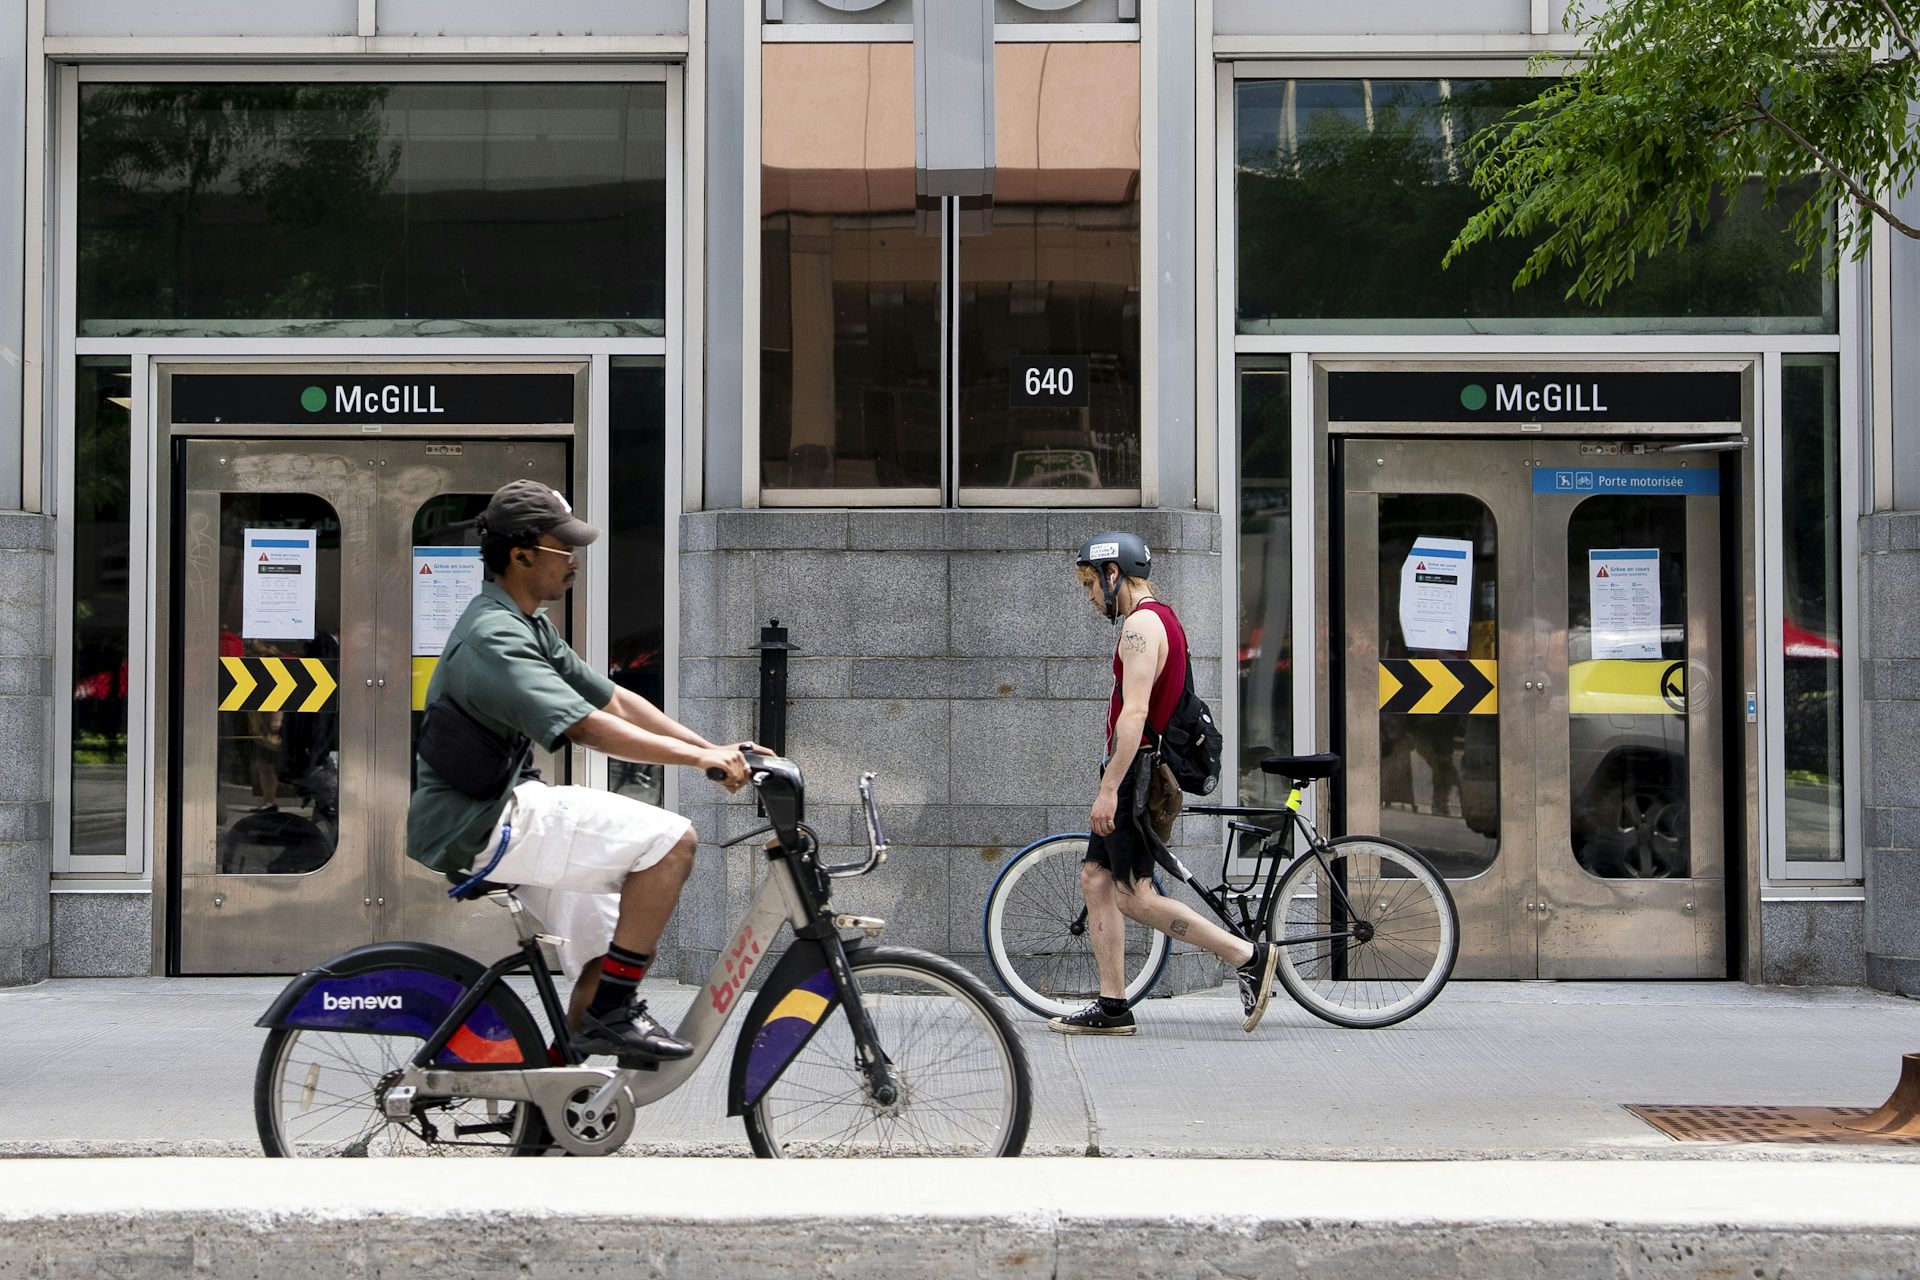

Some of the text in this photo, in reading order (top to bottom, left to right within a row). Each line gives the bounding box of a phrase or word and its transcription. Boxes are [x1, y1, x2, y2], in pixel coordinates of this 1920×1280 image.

[1025, 367, 1074, 396] 640
[335, 385, 445, 413] McGILL
[1496, 383, 1608, 411] McGILL
[1599, 475, 1684, 487] Porte motorisée
[323, 991, 403, 1010] beneva
